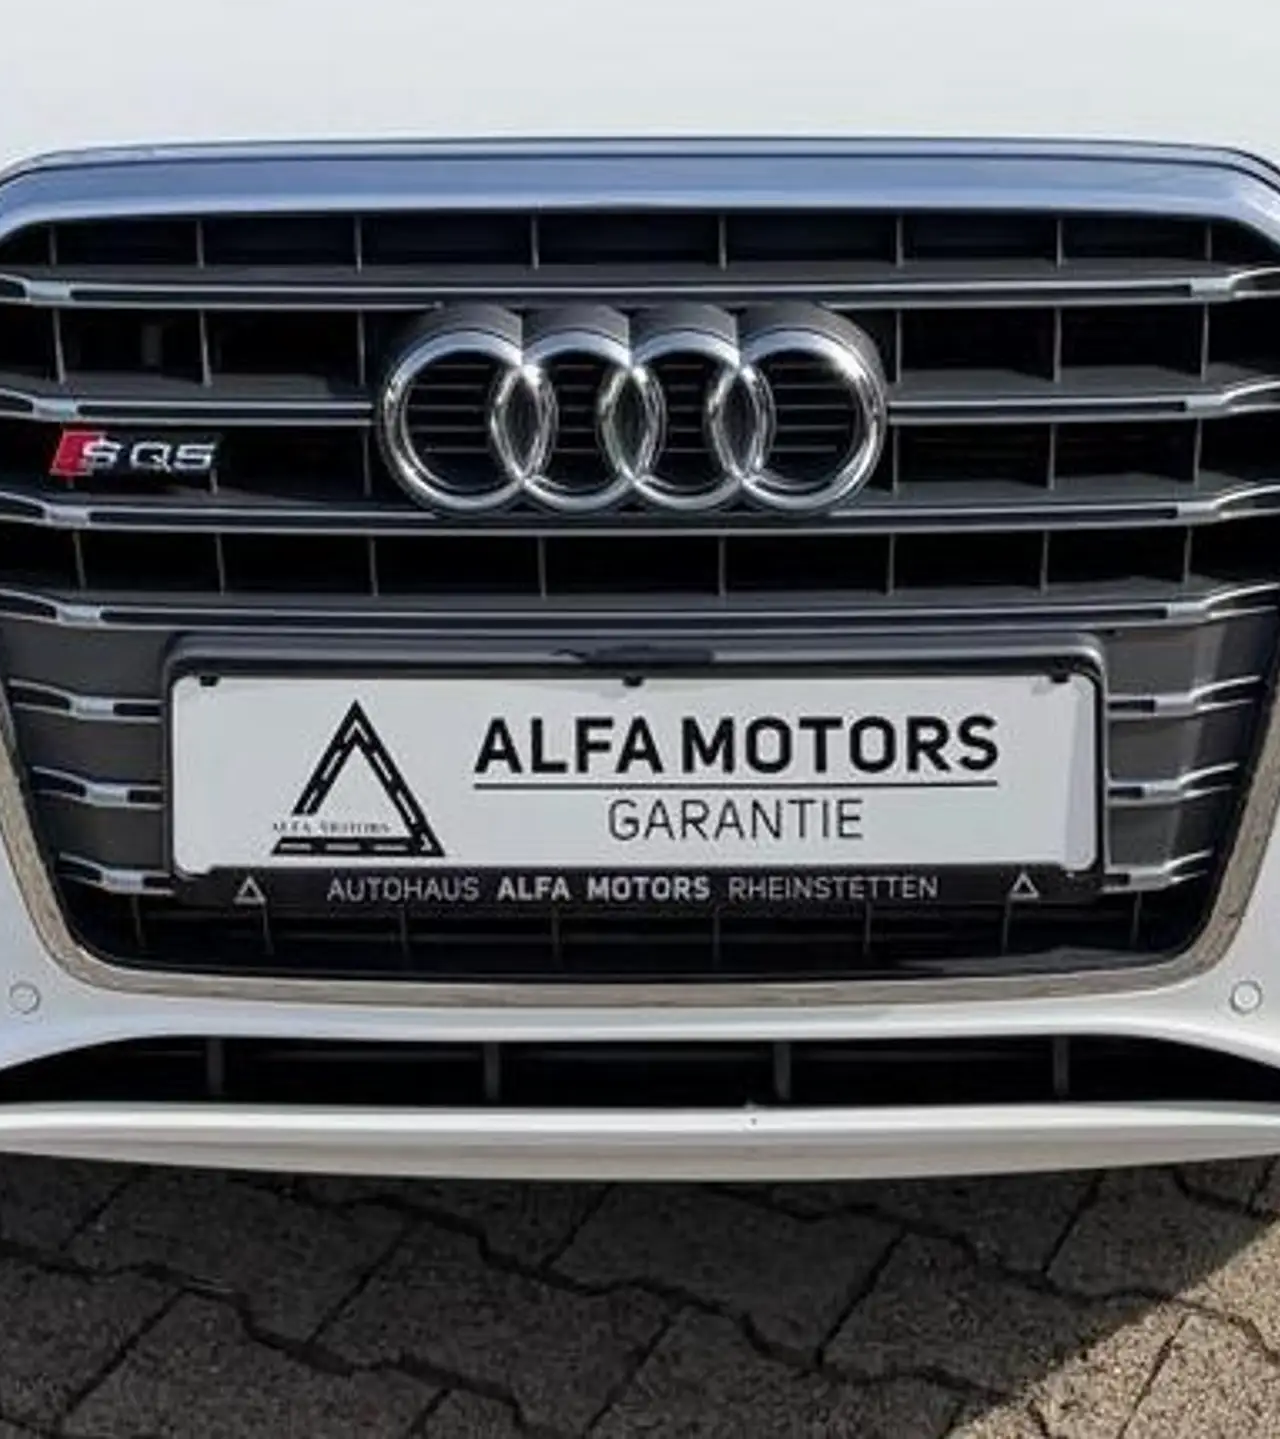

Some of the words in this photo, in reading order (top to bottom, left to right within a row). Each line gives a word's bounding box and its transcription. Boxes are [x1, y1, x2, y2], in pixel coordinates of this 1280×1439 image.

[474, 716, 664, 774] ALFA
[681, 715, 999, 774] MOTORS
[608, 798, 864, 841] GARANTIE
[326, 876, 480, 902] AUTOHAUS
[497, 876, 571, 902] ALFA
[587, 876, 710, 901] MOTORS
[728, 875, 938, 900] RHEINSTETTEN
